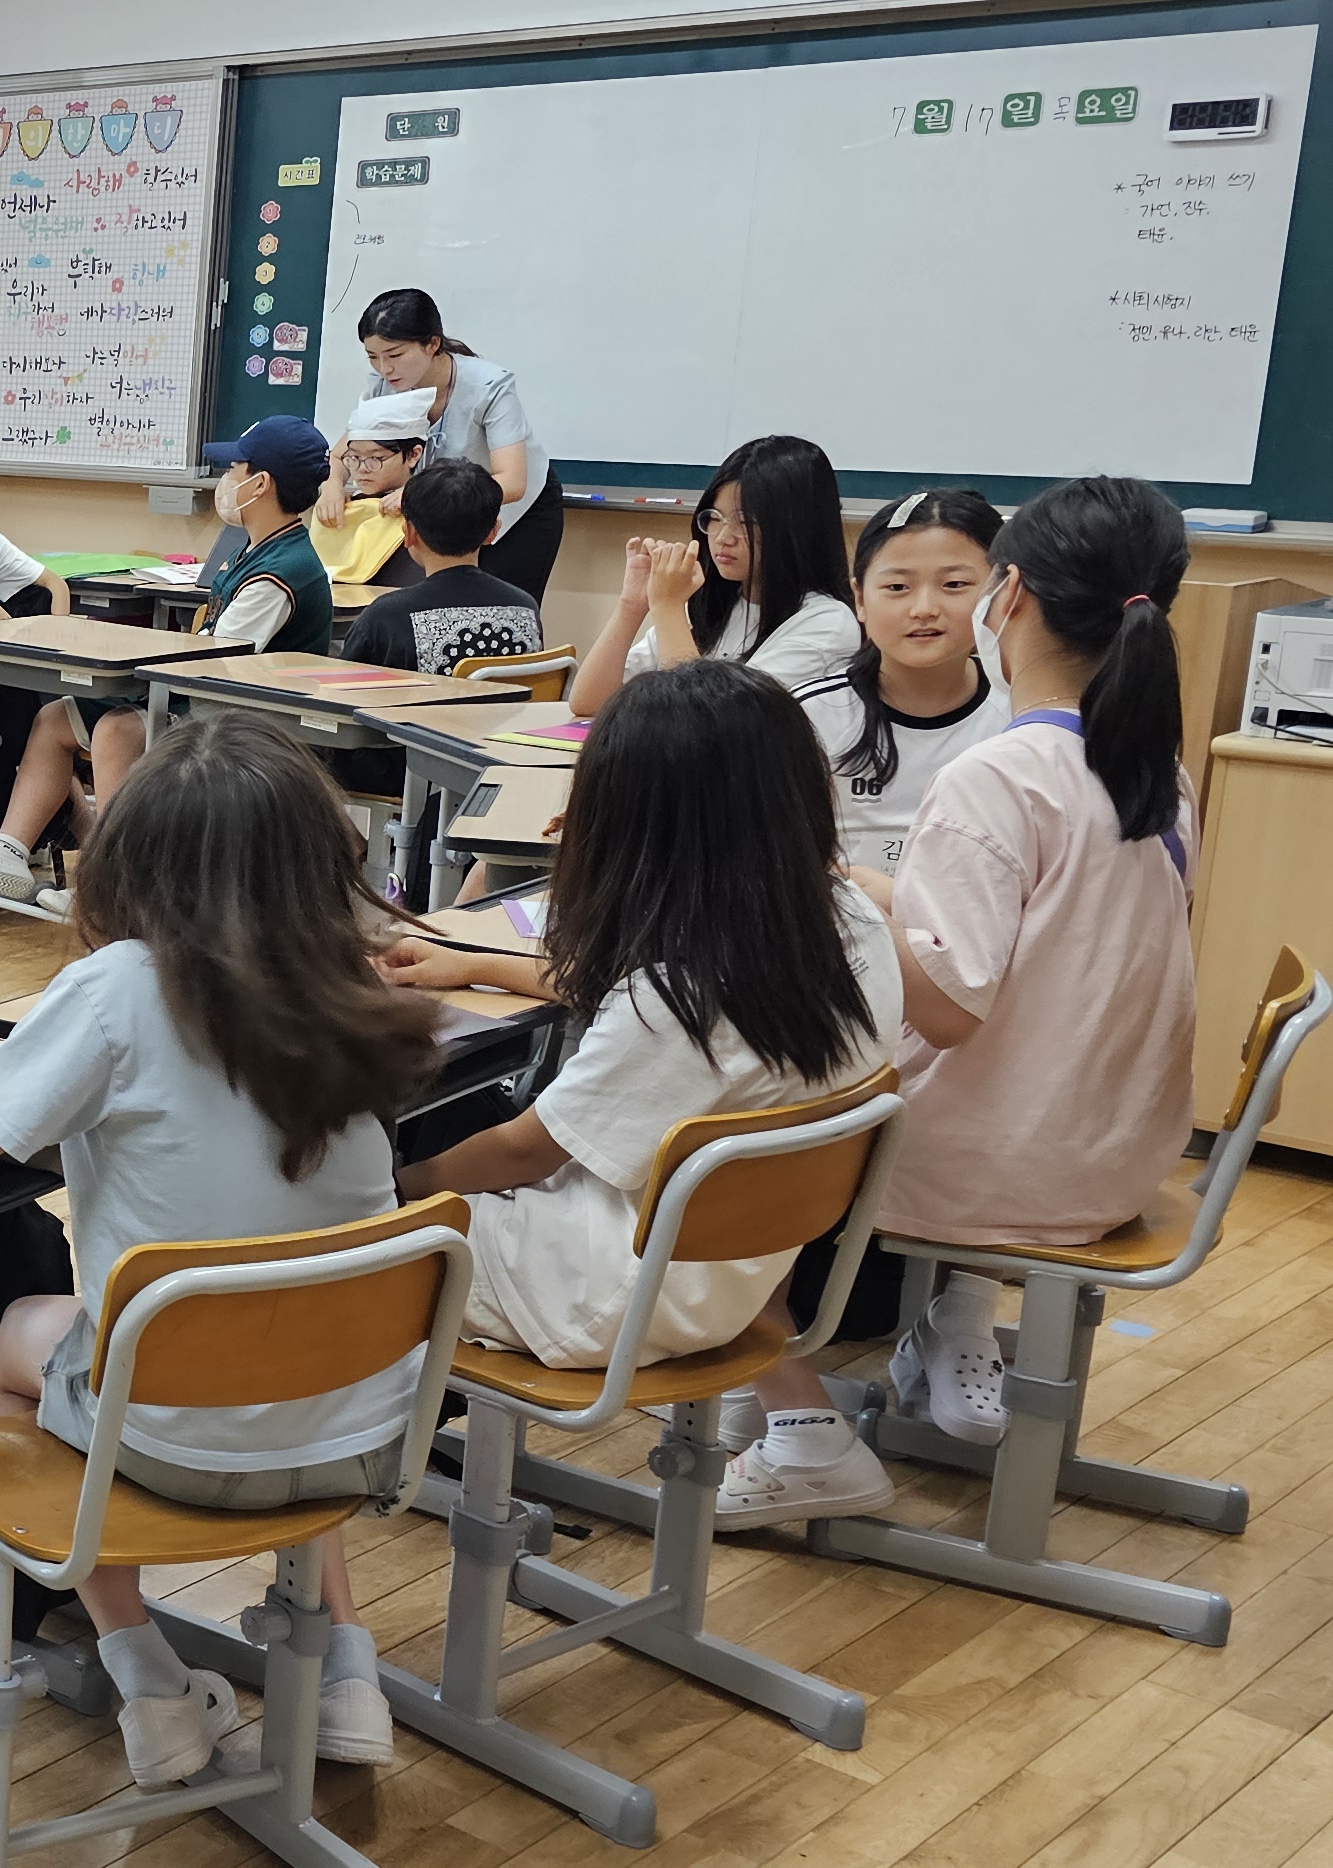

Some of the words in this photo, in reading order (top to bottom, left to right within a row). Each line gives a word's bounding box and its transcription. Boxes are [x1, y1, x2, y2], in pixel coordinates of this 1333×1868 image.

[64, 166, 123, 197] 사랑해
[283, 169, 316, 181] 시간표
[365, 162, 422, 182] 학습문제
[1131, 173, 1162, 197] 국어
[1175, 173, 1215, 191] 이야기
[1227, 171, 1256, 192] 쓰기
[0, 192, 57, 219] 언제나
[68, 254, 112, 289] 부탁해
[132, 260, 167, 286] 힘내
[7, 278, 48, 305] 우리가
[851, 777, 883, 796] 06
[882, 840, 904, 861] 김
[774, 1416, 836, 1427] GIGA
